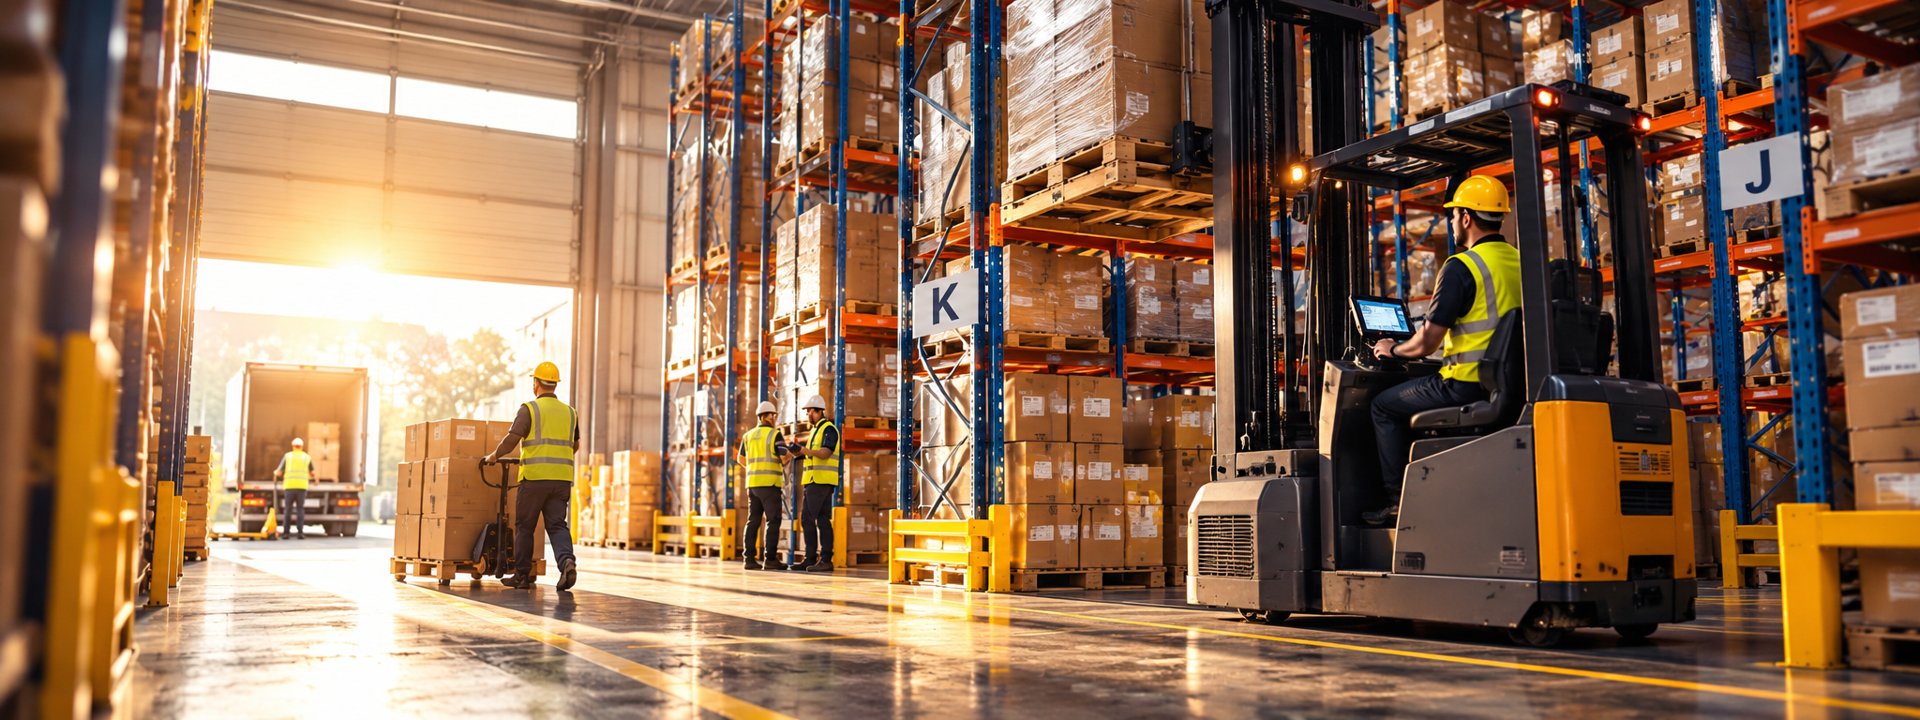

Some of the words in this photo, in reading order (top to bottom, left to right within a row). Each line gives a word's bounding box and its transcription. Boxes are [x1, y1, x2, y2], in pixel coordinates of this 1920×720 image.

[1745, 149, 1771, 194] J
[932, 282, 959, 325] K
[795, 351, 808, 386] K
